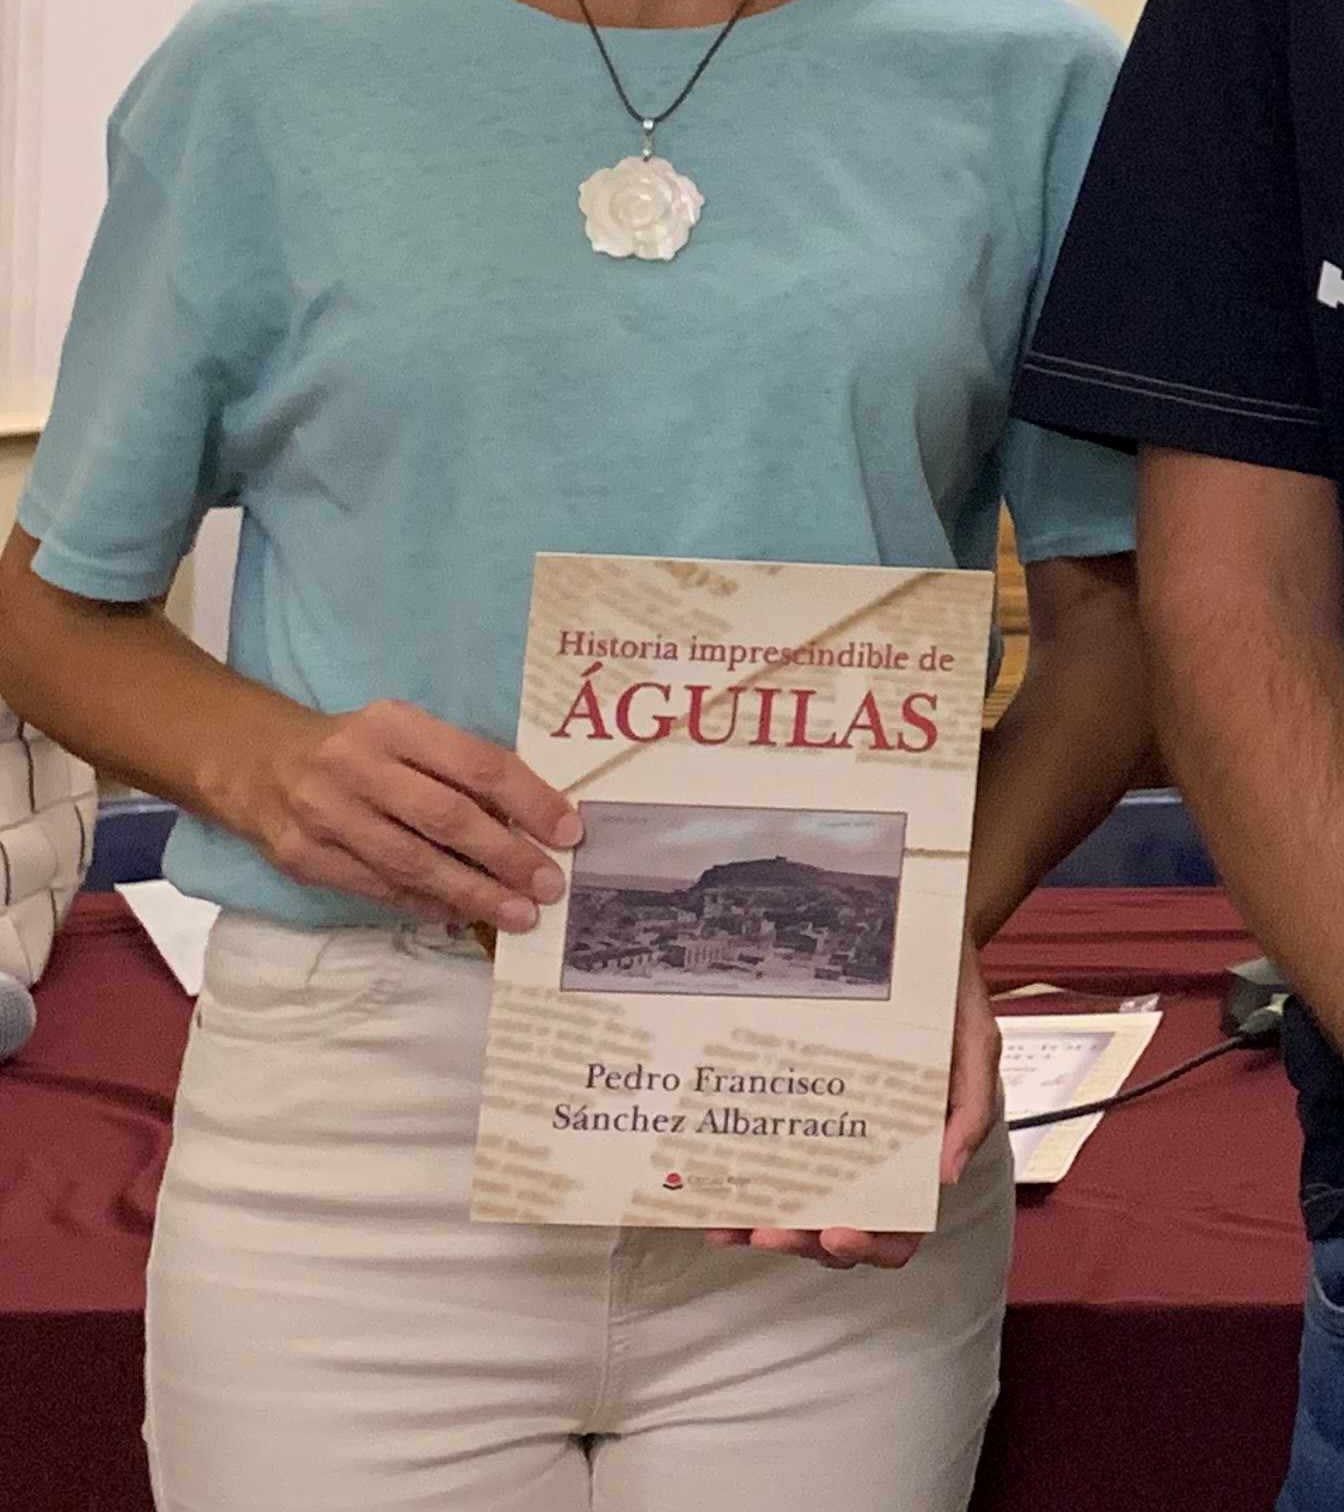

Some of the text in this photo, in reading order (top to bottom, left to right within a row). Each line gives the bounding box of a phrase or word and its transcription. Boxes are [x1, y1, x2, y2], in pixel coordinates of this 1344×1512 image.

[557, 630, 955, 671] Historia imprescindible de
[550, 661, 939, 752] ÁGUILAS
[585, 1063, 845, 1095] Pedro Francisco
[552, 1103, 868, 1137] Sánchez Albarracín
